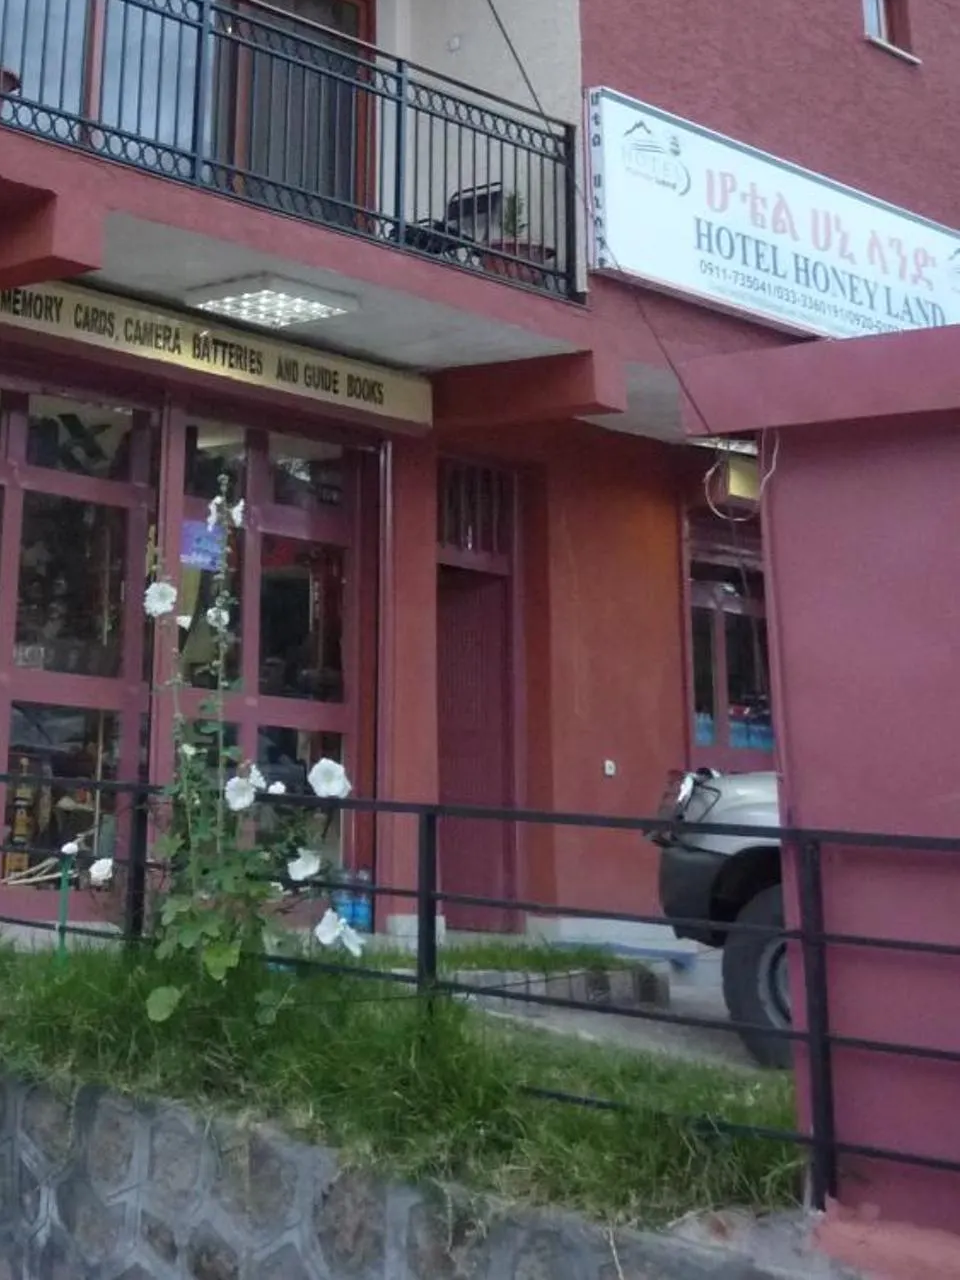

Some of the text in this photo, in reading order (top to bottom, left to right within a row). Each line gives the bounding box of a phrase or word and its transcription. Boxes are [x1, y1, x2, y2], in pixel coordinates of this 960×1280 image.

[693, 216, 788, 279] HOTEL
[792, 252, 878, 313] HONEY
[884, 285, 946, 328] LAND
[0, 289, 63, 324] MEMORY
[123, 317, 181, 355] CAMERA
[193, 332, 263, 376] BATTERIES
[275, 357, 299, 384] AND
[304, 362, 339, 395] GUIDE
[346, 373, 384, 405] BOOKS
